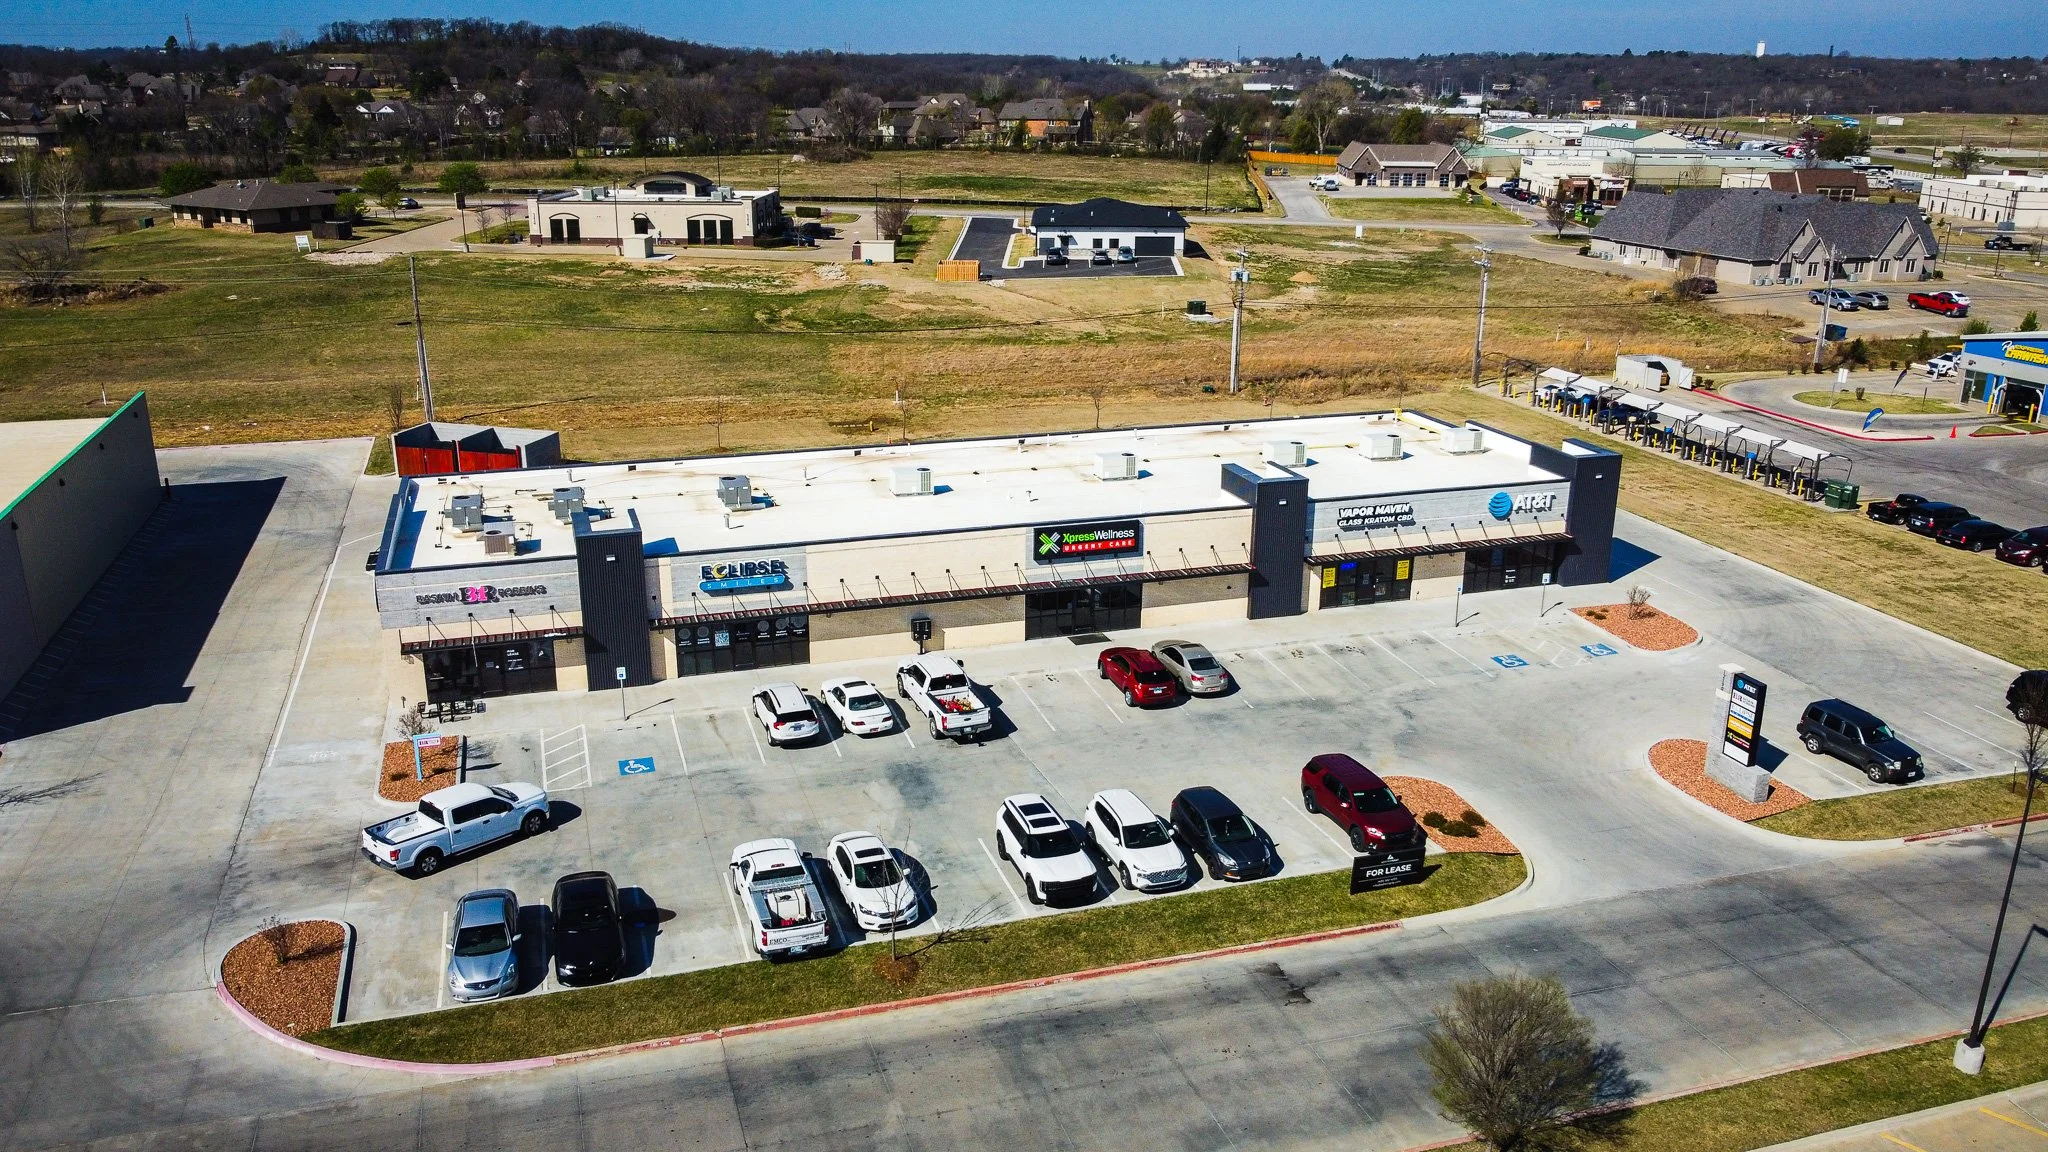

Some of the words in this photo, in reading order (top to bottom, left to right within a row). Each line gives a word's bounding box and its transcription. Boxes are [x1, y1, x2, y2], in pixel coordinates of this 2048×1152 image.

[1513, 492, 1554, 511] AT&T
[1339, 505, 1375, 518] VAPOR
[1376, 503, 1411, 515] MAVEN
[1338, 518, 1363, 527] GLASS
[1364, 515, 1395, 524] KRATOM
[1397, 514, 1413, 522] CBD
[1063, 529, 1135, 543] XpressWellness
[1064, 543, 1103, 552] URGENT
[1109, 540, 1132, 548] CARE
[700, 559, 783, 580] ECLIPSE
[707, 578, 779, 589] SMILES
[498, 585, 548, 598] ROBBINS
[1366, 868, 1384, 878] FOR
[1385, 864, 1412, 875] LEASE
